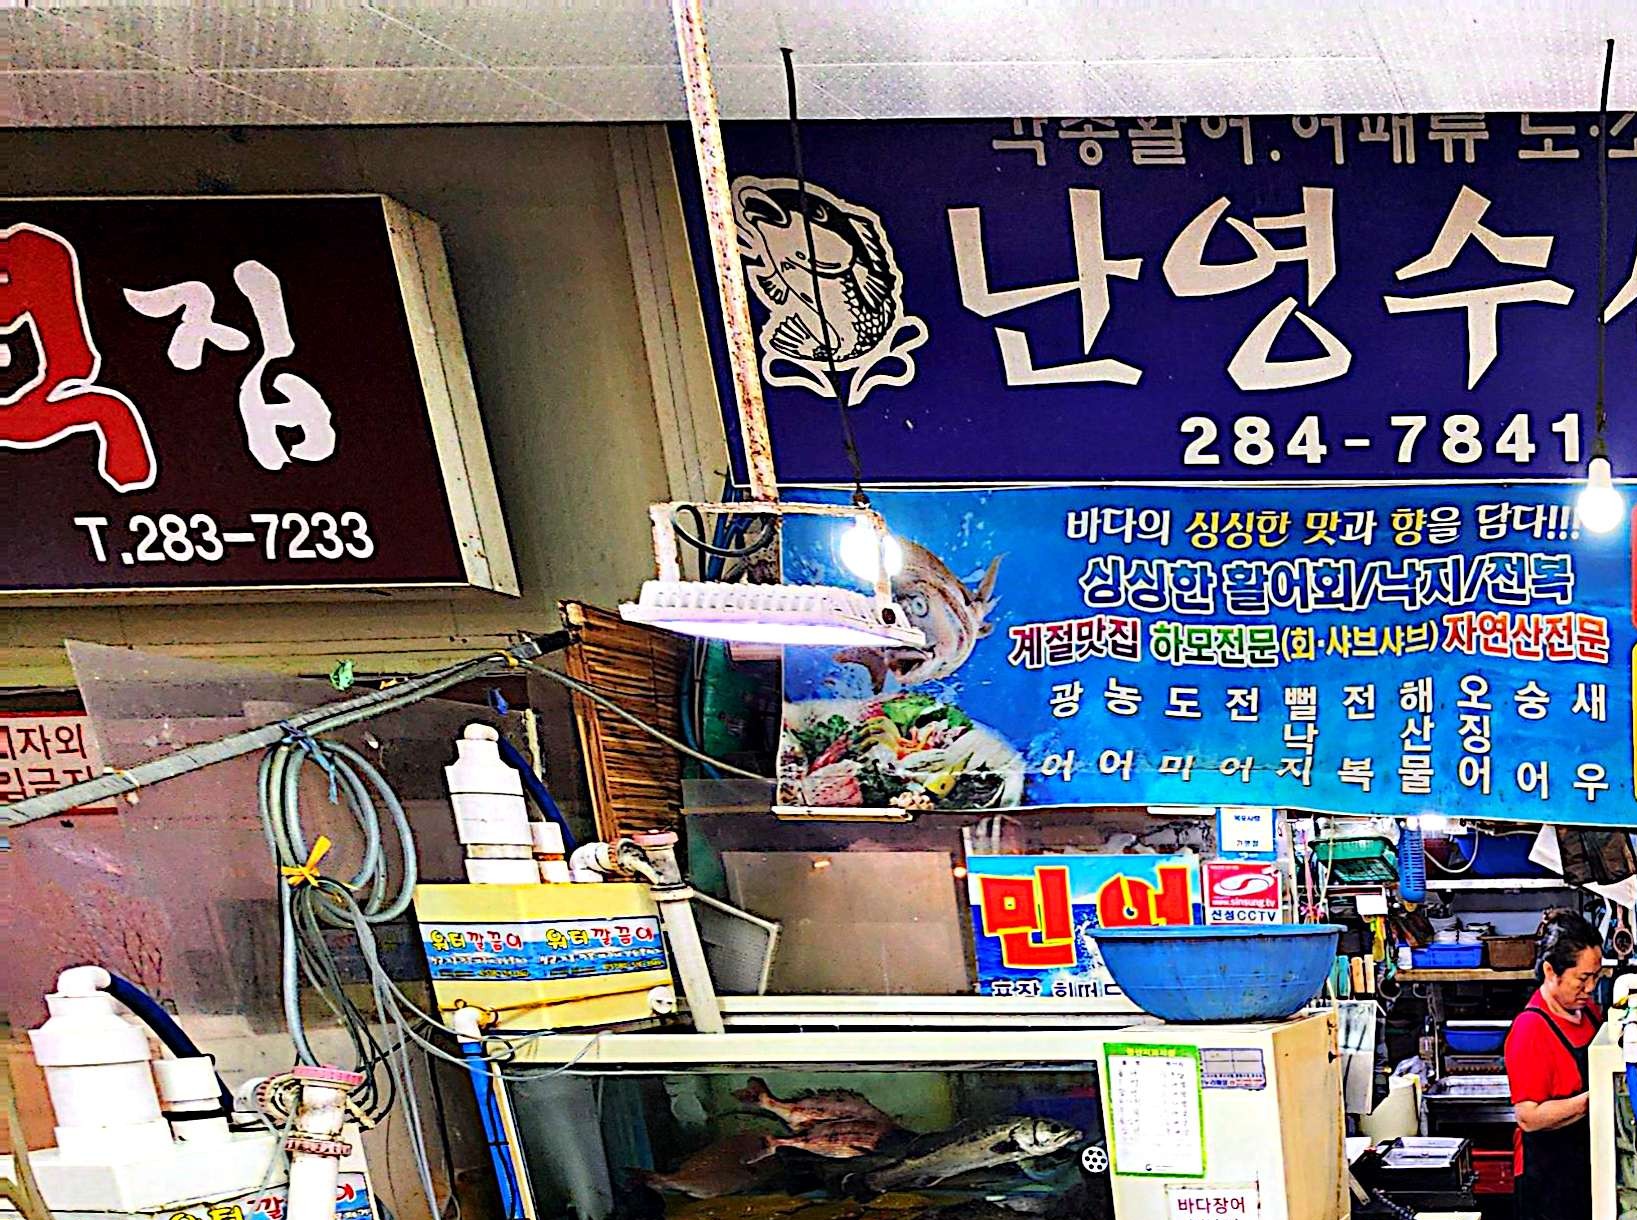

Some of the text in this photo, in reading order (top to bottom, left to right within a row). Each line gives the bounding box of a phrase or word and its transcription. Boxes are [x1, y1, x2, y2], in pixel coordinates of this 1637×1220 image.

[1180, 412, 1582, 466] 284-7841
[74, 510, 375, 566] T.283-7233
[1066, 502, 1581, 549] 바다의 싱싱한 맛과 향을 담다!!!
[1079, 553, 1575, 615] 싱싱한 활어회/낙지/전복
[1008, 614, 1142, 669] 계절맛집
[1443, 610, 1611, 663] 자연산전문
[1040, 680, 1084, 783] 광어
[1098, 677, 1142, 782] 농어
[1157, 686, 1202, 783] 도미
[1218, 687, 1260, 784] 전어
[1276, 686, 1320, 787] 뻘낙지
[1337, 683, 1376, 792] 전복
[1398, 676, 1435, 795] 해산물
[1456, 673, 1493, 796] 오징어
[1514, 679, 1551, 800] 숭어
[1571, 682, 1610, 802] 새우
[978, 864, 1195, 970] 민어
[1211, 909, 1277, 922] 신성CCTV
[1177, 1196, 1247, 1215] 바다장어
